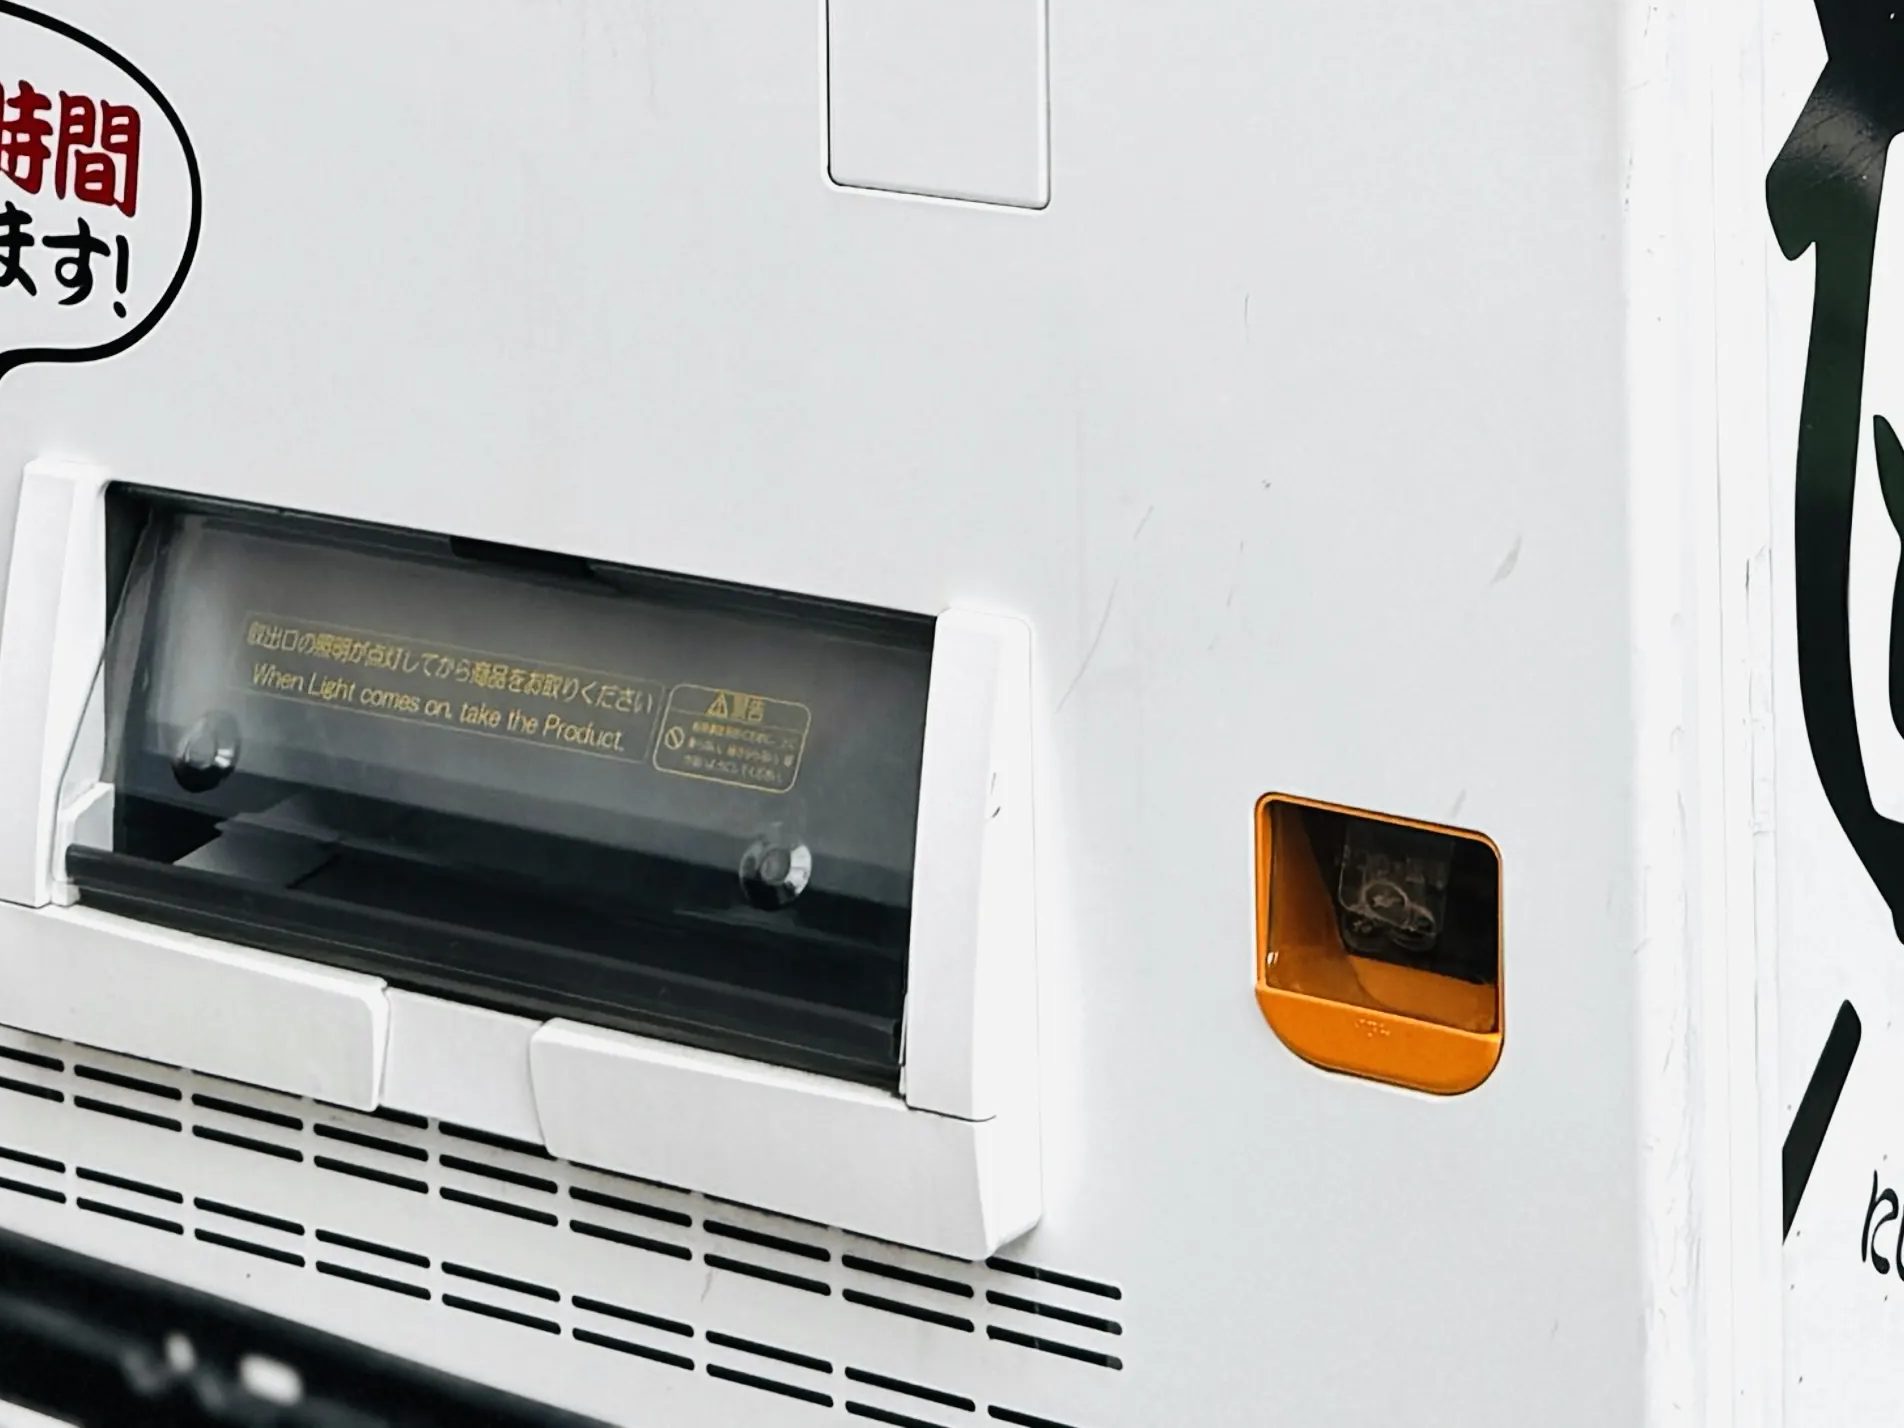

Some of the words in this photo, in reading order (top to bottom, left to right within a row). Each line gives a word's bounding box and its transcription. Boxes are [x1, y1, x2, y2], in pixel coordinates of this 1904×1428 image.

[252, 662, 304, 692] When
[307, 671, 357, 702] Light
[360, 687, 420, 713] comes
[460, 702, 501, 728] take
[507, 708, 539, 735] the
